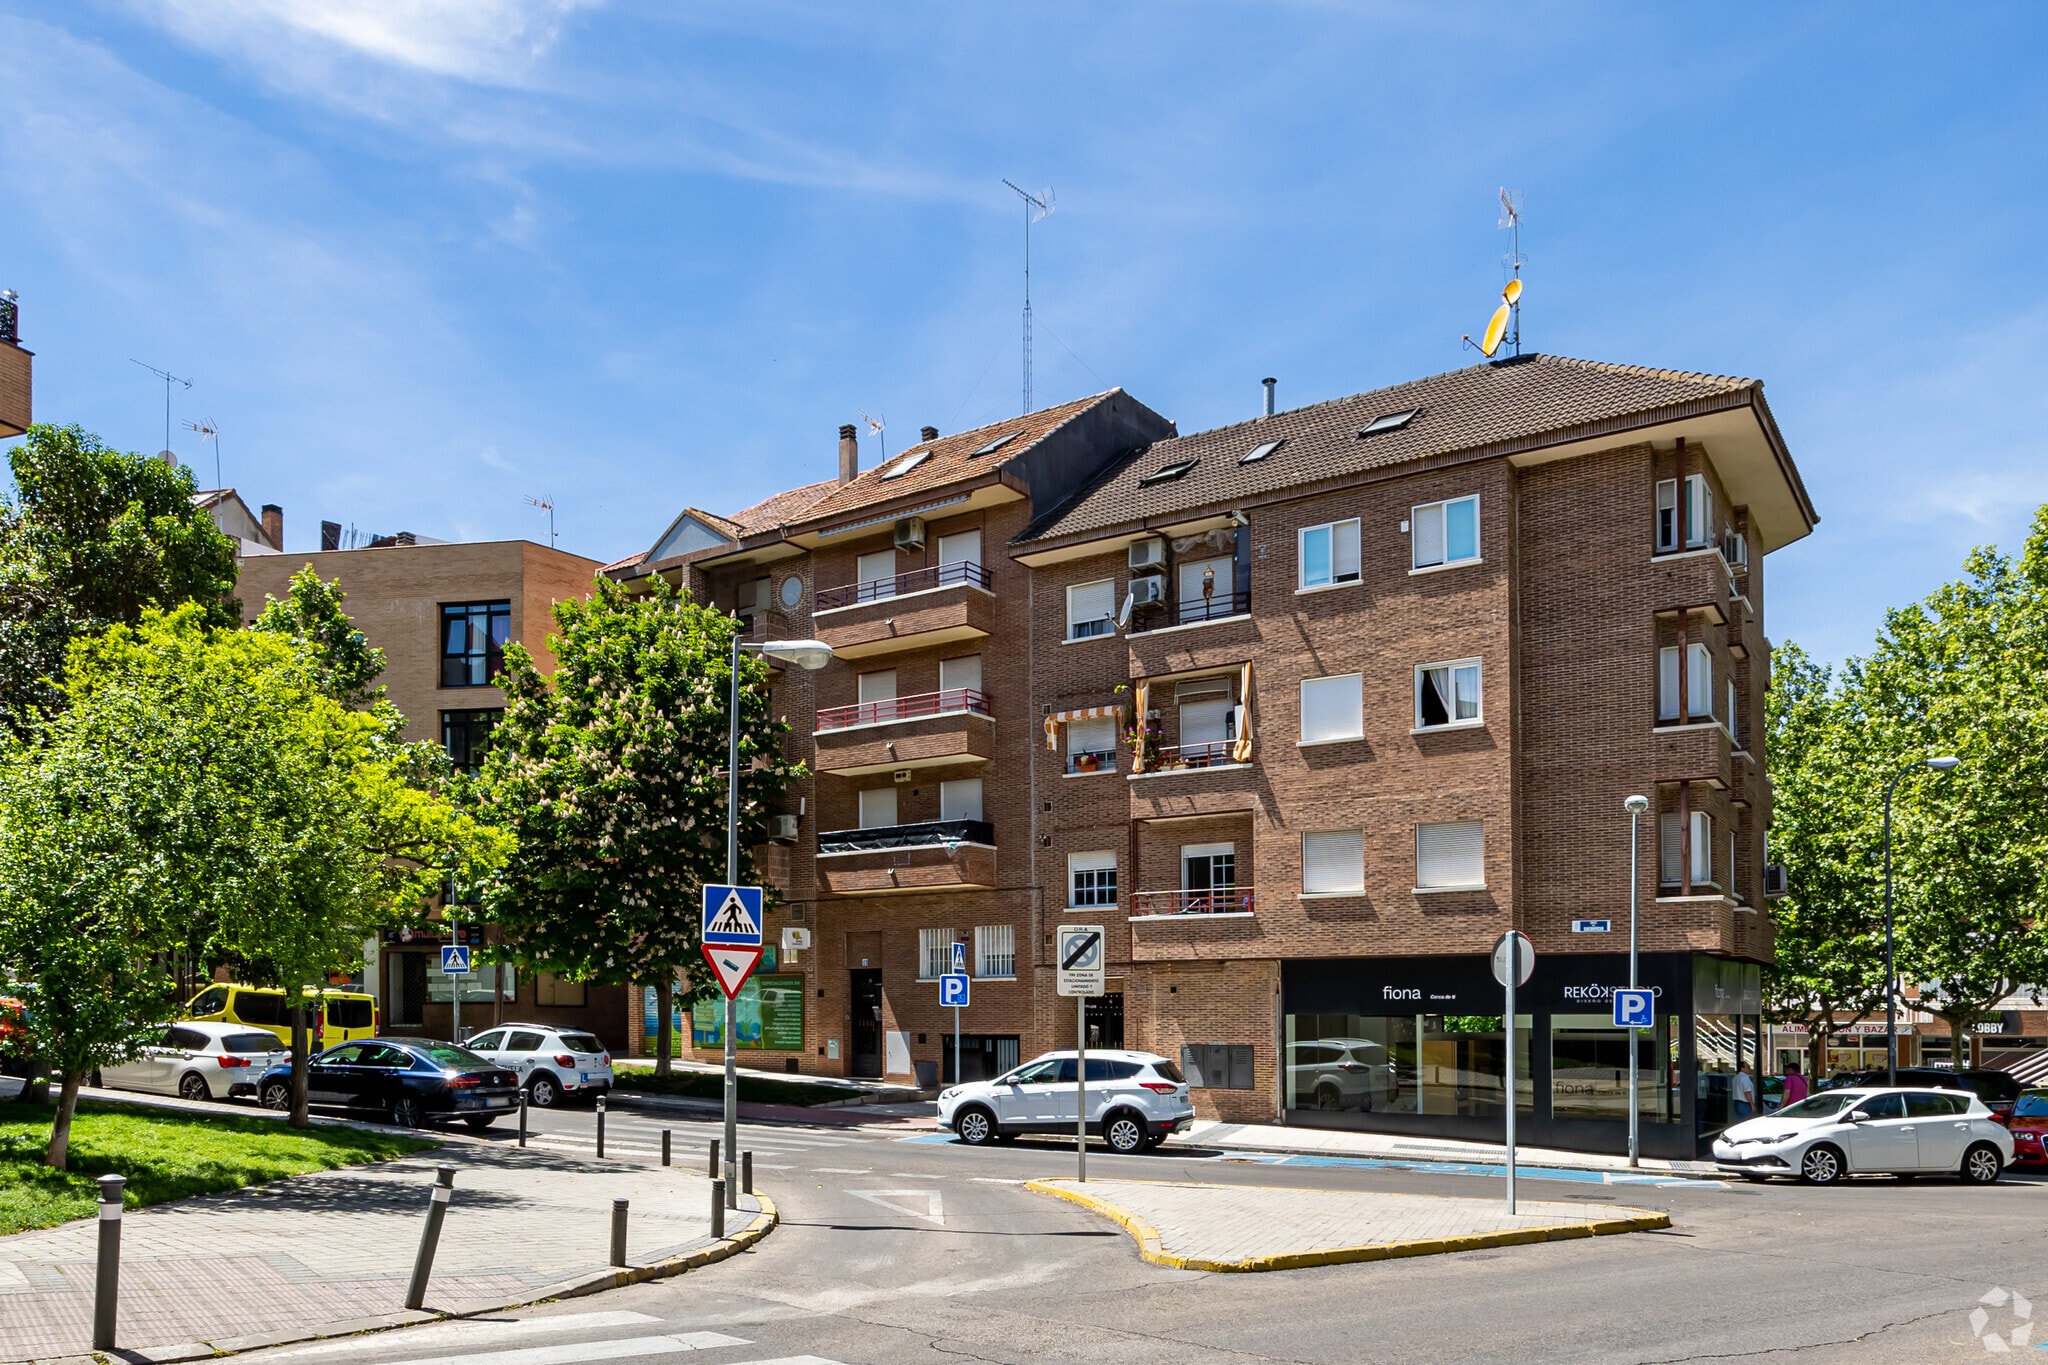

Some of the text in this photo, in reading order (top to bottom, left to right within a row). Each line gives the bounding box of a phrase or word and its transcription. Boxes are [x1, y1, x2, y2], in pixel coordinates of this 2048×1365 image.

[946, 979, 963, 1003] P
[1382, 985, 1422, 1000] fiona
[1622, 994, 1646, 1022] P
[1556, 1081, 1594, 1096] fiona
